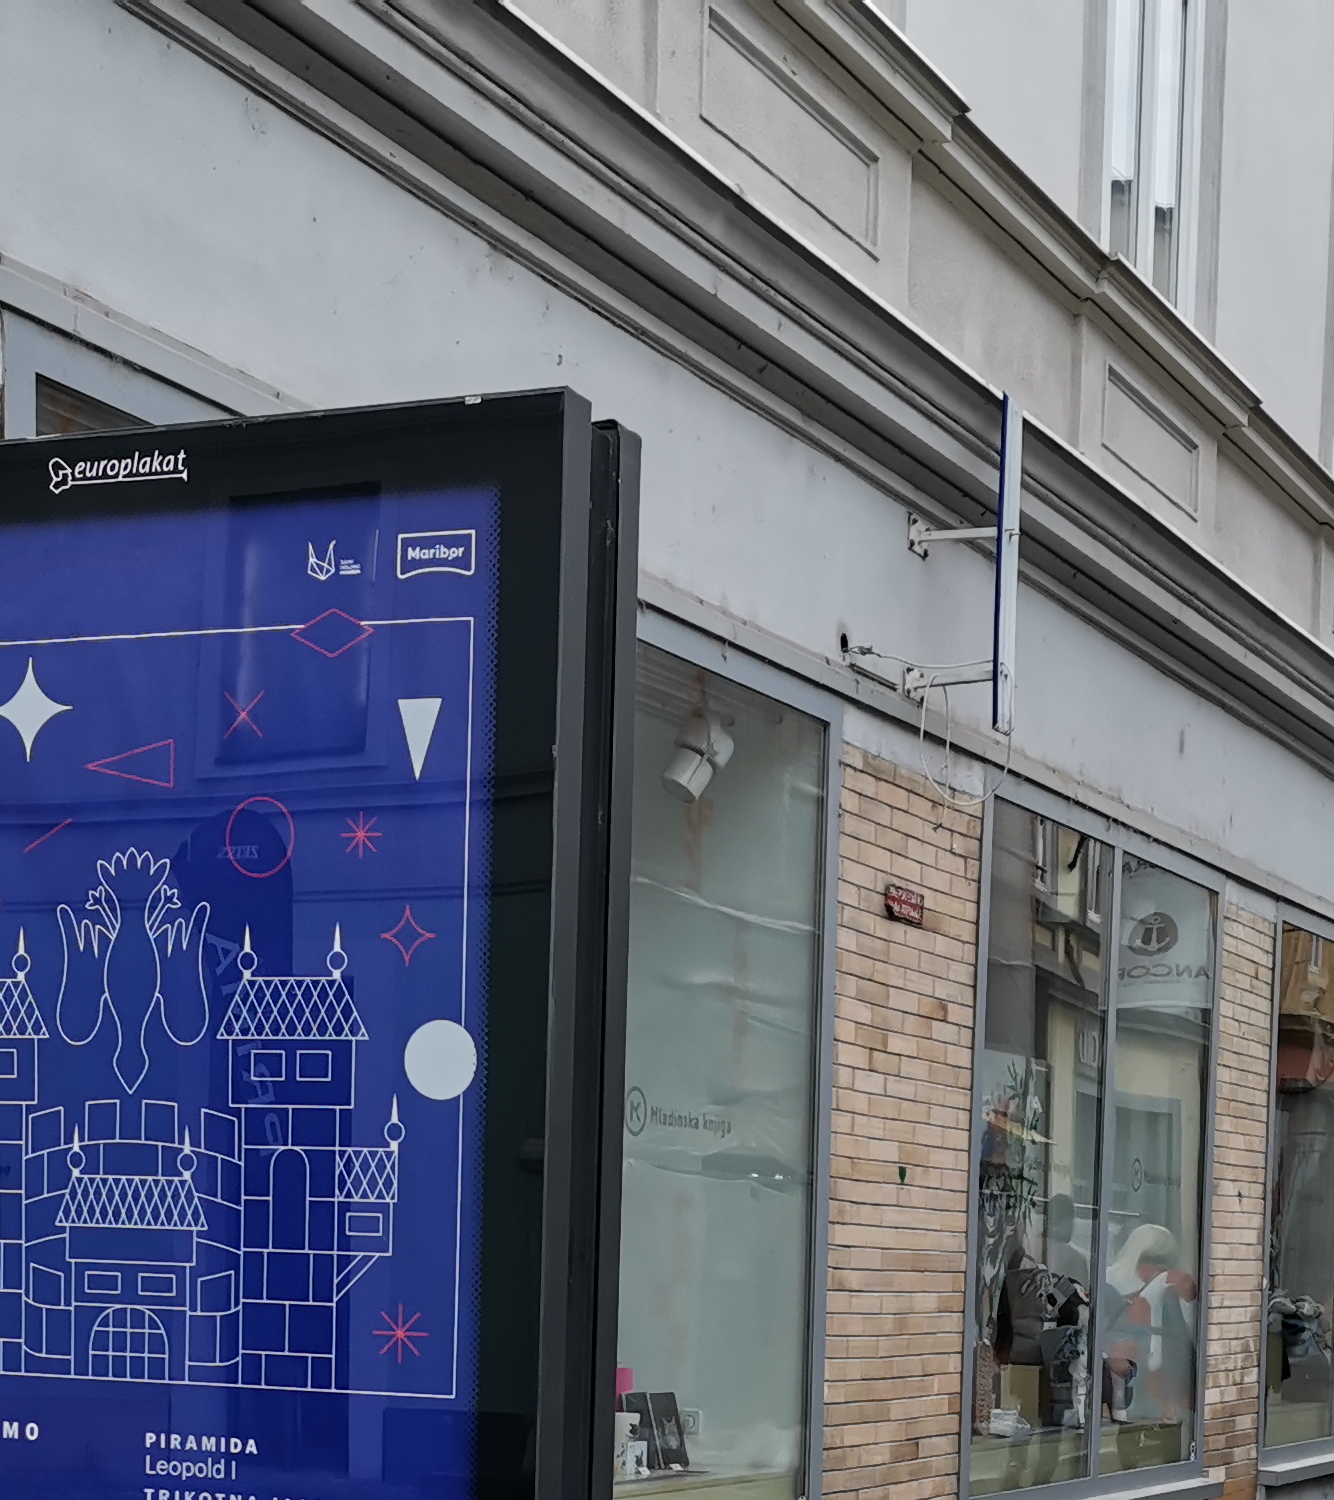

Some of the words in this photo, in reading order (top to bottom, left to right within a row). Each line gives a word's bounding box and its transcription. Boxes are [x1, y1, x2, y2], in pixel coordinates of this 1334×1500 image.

[74, 449, 187, 480] europlakat
[407, 544, 465, 561] Maribor
[144, 1432, 259, 1455] PIRAMIDA
[144, 1455, 225, 1481] Leopold
[231, 1460, 237, 1480] I
